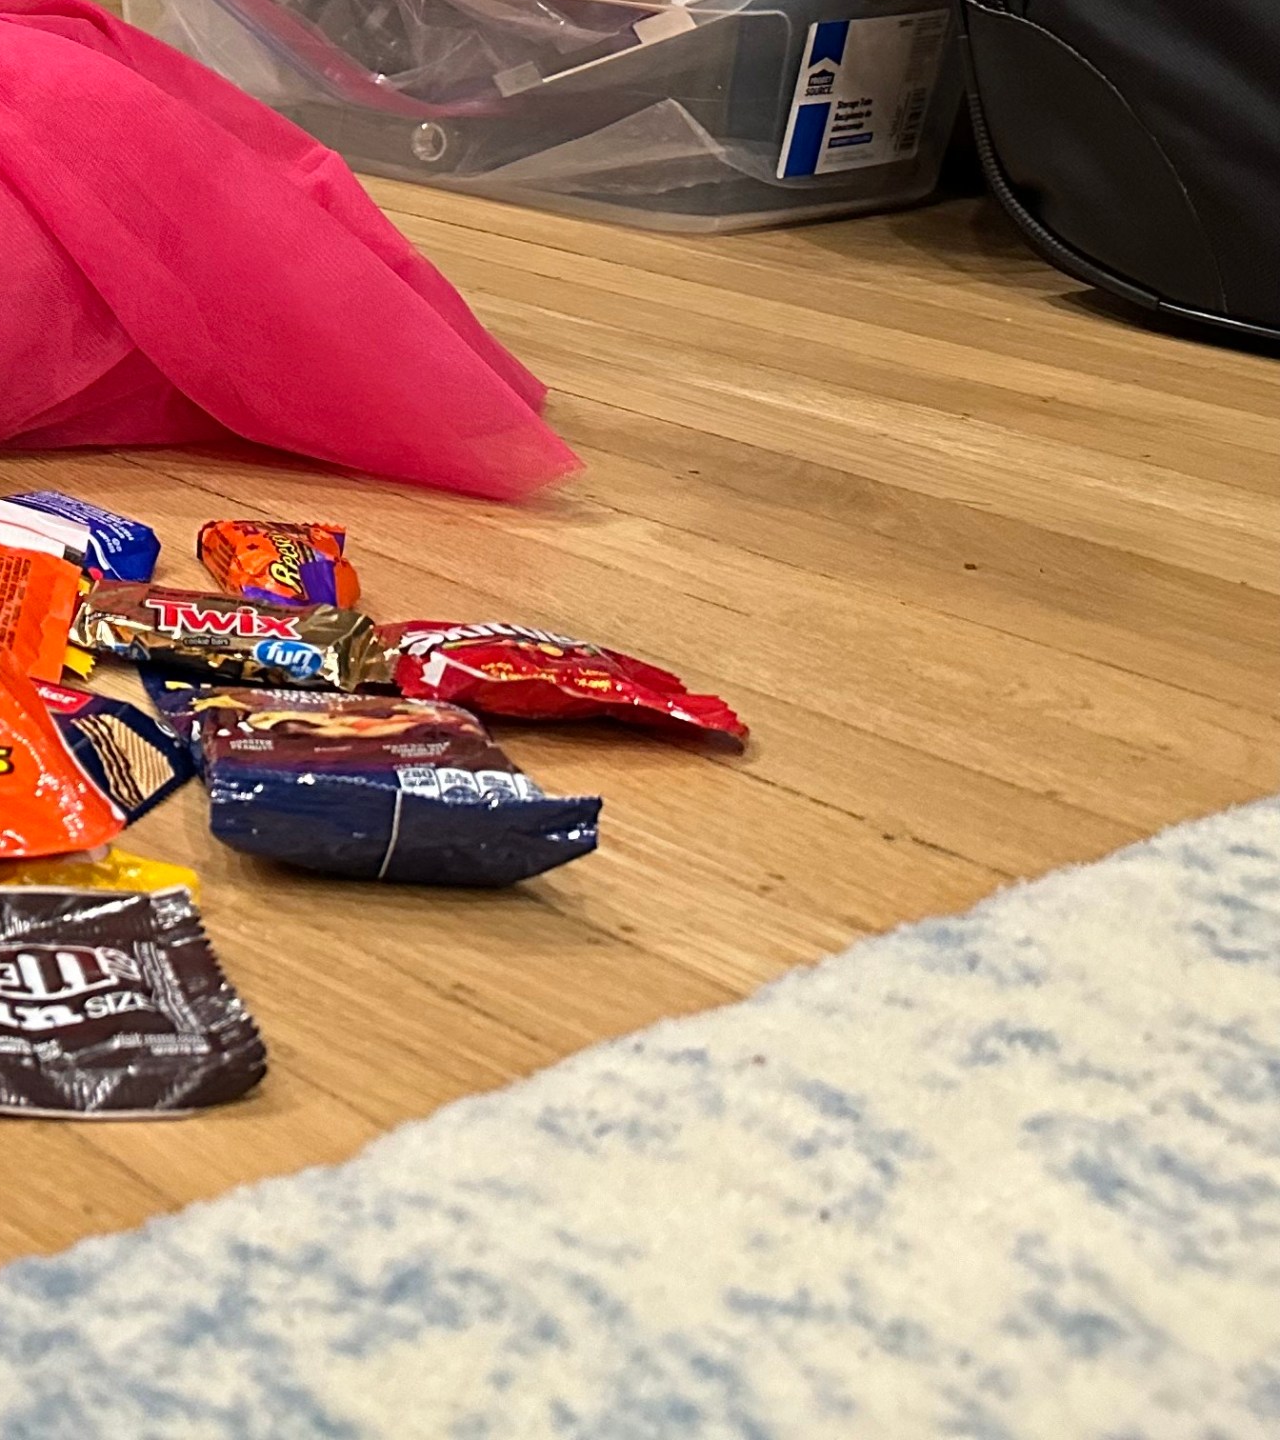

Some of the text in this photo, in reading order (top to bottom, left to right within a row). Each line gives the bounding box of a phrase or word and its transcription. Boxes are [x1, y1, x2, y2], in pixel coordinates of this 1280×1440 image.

[144, 595, 304, 641] Twix
[262, 638, 314, 668] fun
[83, 991, 162, 1021] SIZE
